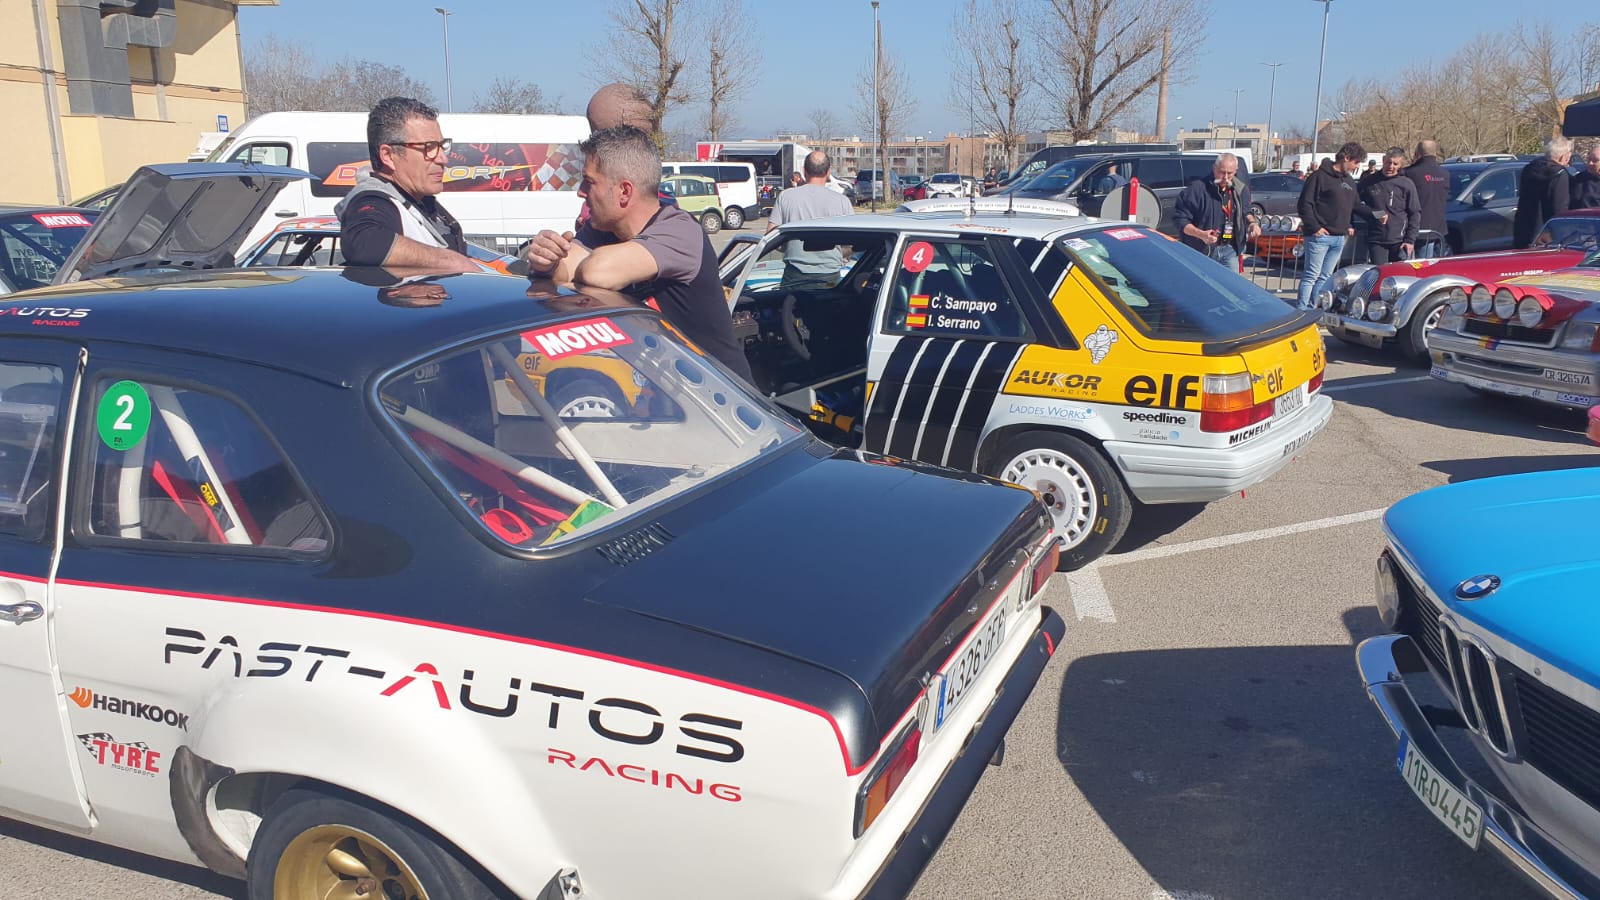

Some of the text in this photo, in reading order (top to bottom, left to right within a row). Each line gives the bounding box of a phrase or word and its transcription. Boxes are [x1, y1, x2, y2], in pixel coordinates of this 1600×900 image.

[490, 175, 511, 191] 160
[40, 215, 89, 226] MOTUL
[912, 248, 925, 264] 4
[931, 296, 997, 314] C. Sampayo
[32, 319, 81, 327] RACING
[937, 315, 981, 330] Serrano
[535, 322, 626, 357] MOTUL
[524, 356, 541, 371] elf
[1312, 347, 1321, 372] elf
[1051, 388, 1098, 397] RACING
[1124, 373, 1200, 410] elf
[1267, 366, 1284, 395] elf
[113, 394, 135, 430] 2
[1122, 411, 1187, 425] speedline
[1228, 421, 1272, 445] MICHELIN
[201, 483, 217, 508] OMP
[946, 638, 982, 706] 4326
[165, 627, 745, 763] PAST-AUTOS
[92, 740, 161, 773] TYRE
[548, 748, 743, 803] RACING
